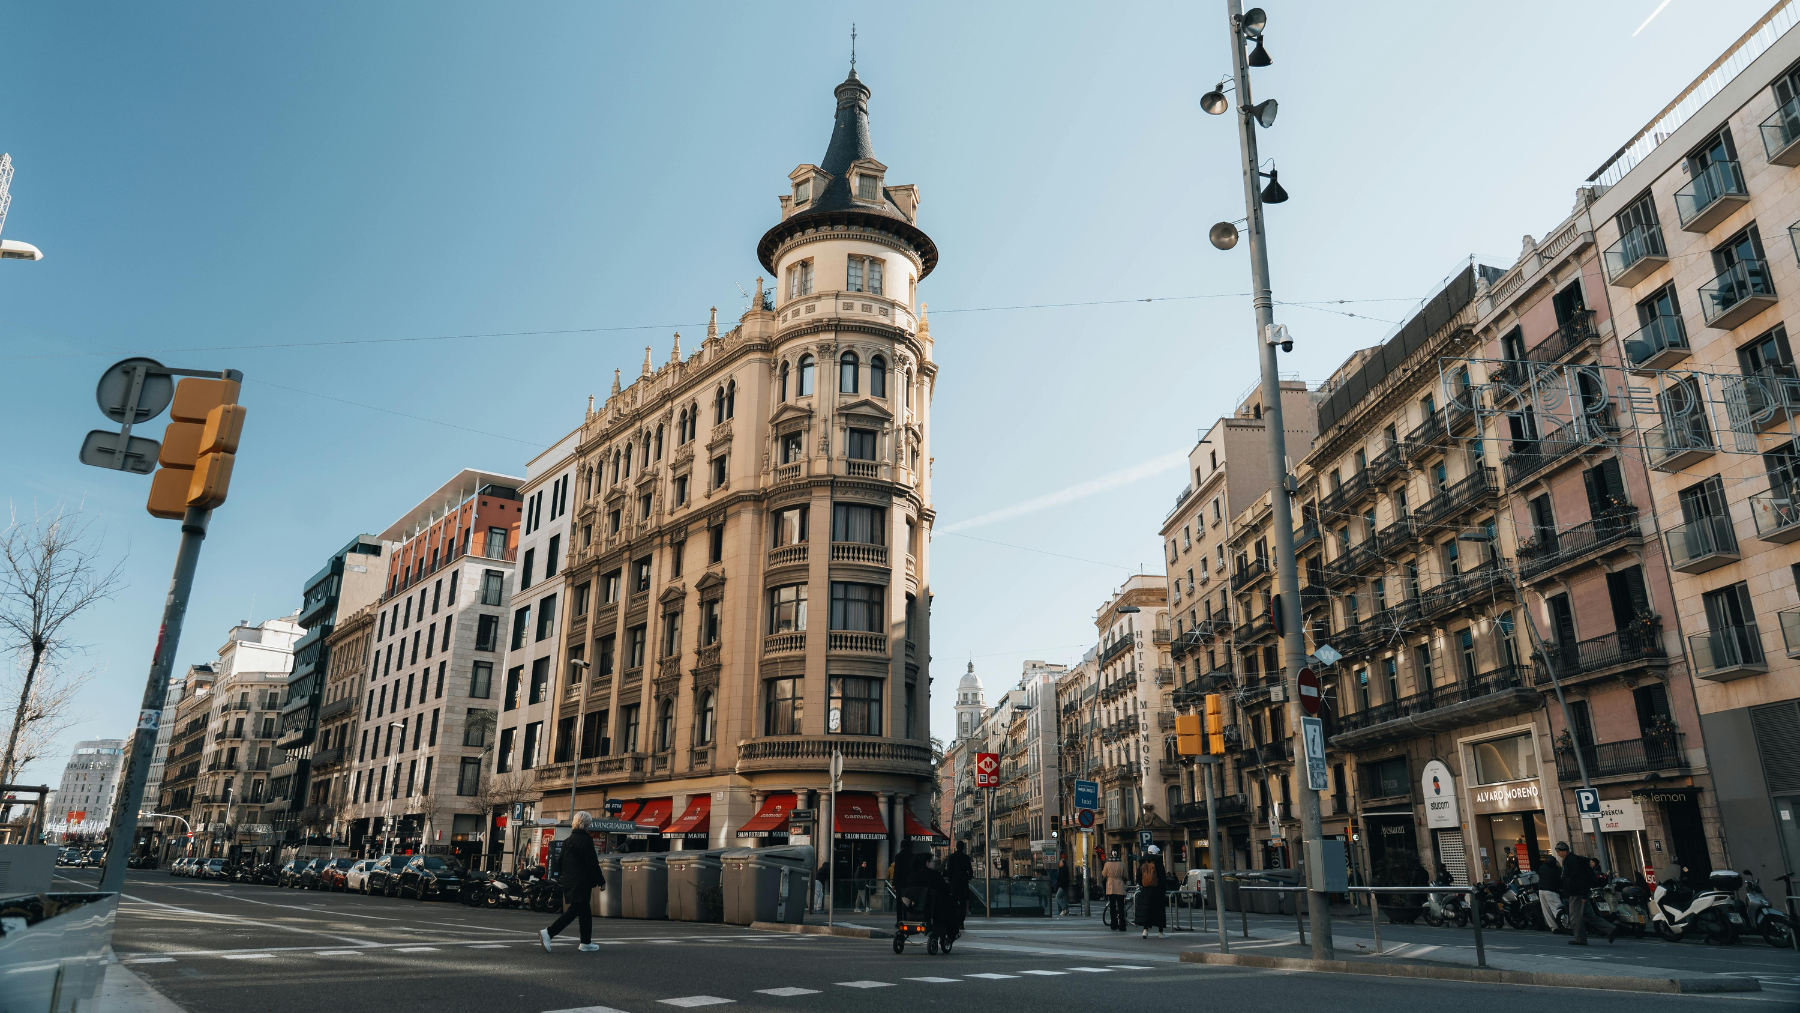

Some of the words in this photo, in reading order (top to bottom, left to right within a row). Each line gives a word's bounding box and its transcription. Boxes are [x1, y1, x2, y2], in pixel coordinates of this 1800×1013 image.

[1136, 631, 1145, 682] HOTEL
[1320, 651, 1334, 660] W
[1140, 701, 1150, 776] MIDMOST
[984, 761, 992, 769] M
[1477, 790, 1504, 802] ALVARO
[1505, 786, 1539, 800] MORENO
[1651, 792, 1687, 802] lemon
[1431, 801, 1450, 810] stucom
[1580, 792, 1594, 811] P
[515, 805, 521, 818] P
[594, 821, 634, 830] VANGUARDIA
[1142, 833, 1151, 844] P
